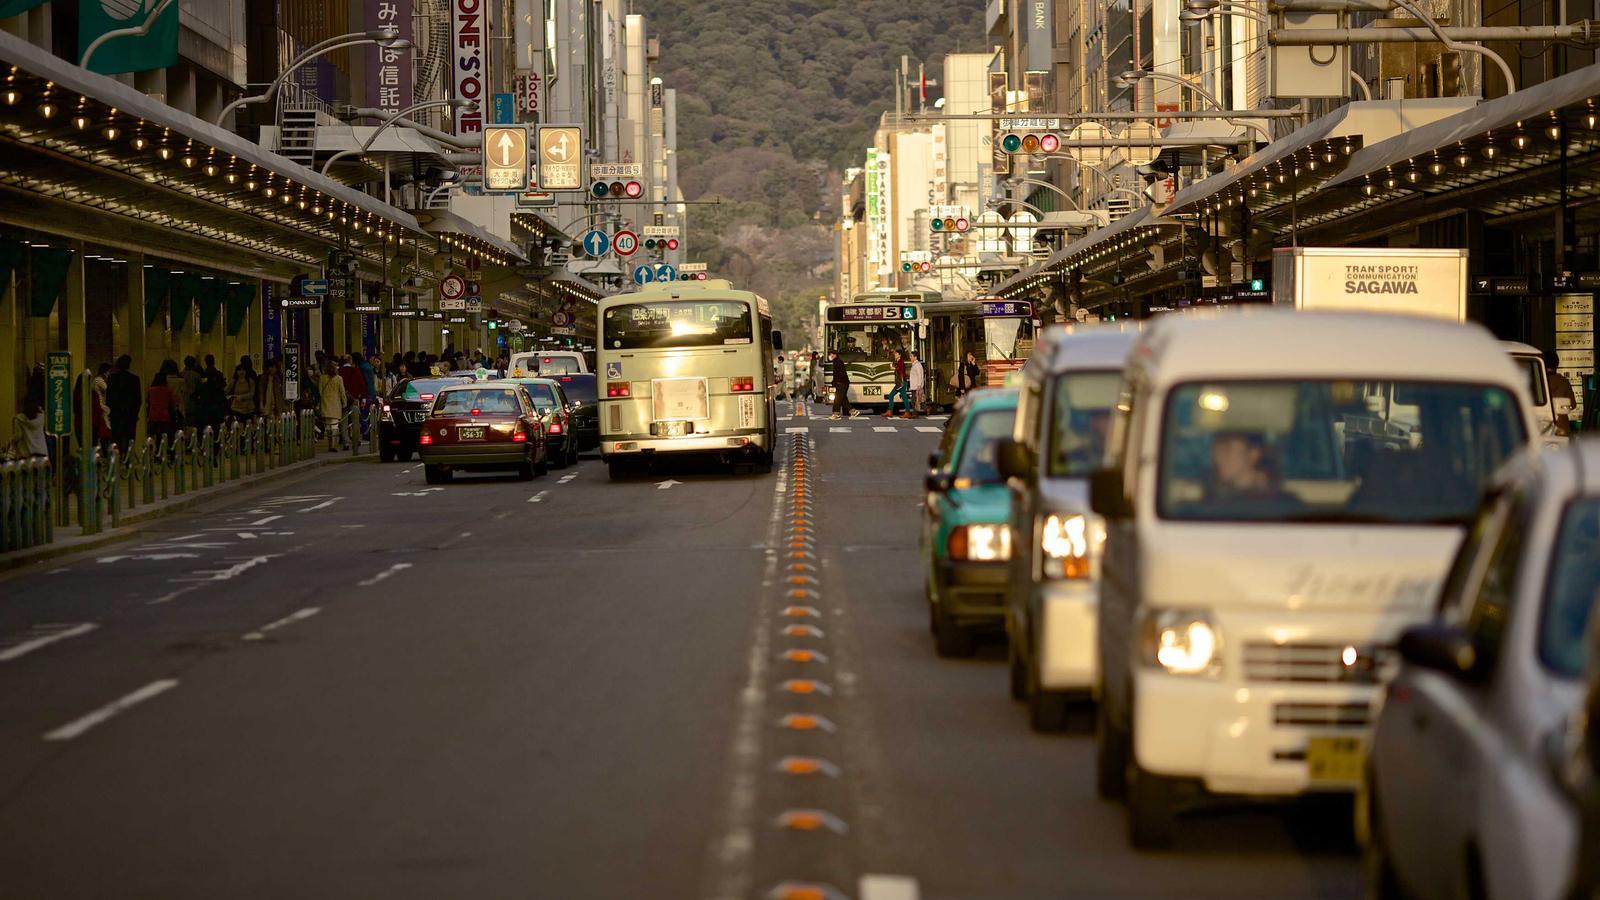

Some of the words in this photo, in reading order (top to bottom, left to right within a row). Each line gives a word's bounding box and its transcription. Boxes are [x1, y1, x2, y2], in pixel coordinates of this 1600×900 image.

[1034, 1, 1045, 29] BANK
[529, 73, 541, 113] doco
[593, 165, 640, 174] 歩車分離信号
[879, 172, 888, 266] TAKASHIMAYA
[619, 237, 633, 249] 40
[1345, 281, 1418, 294] SAGAWA
[886, 307, 898, 318] 5
[49, 356, 68, 365] TAXI
